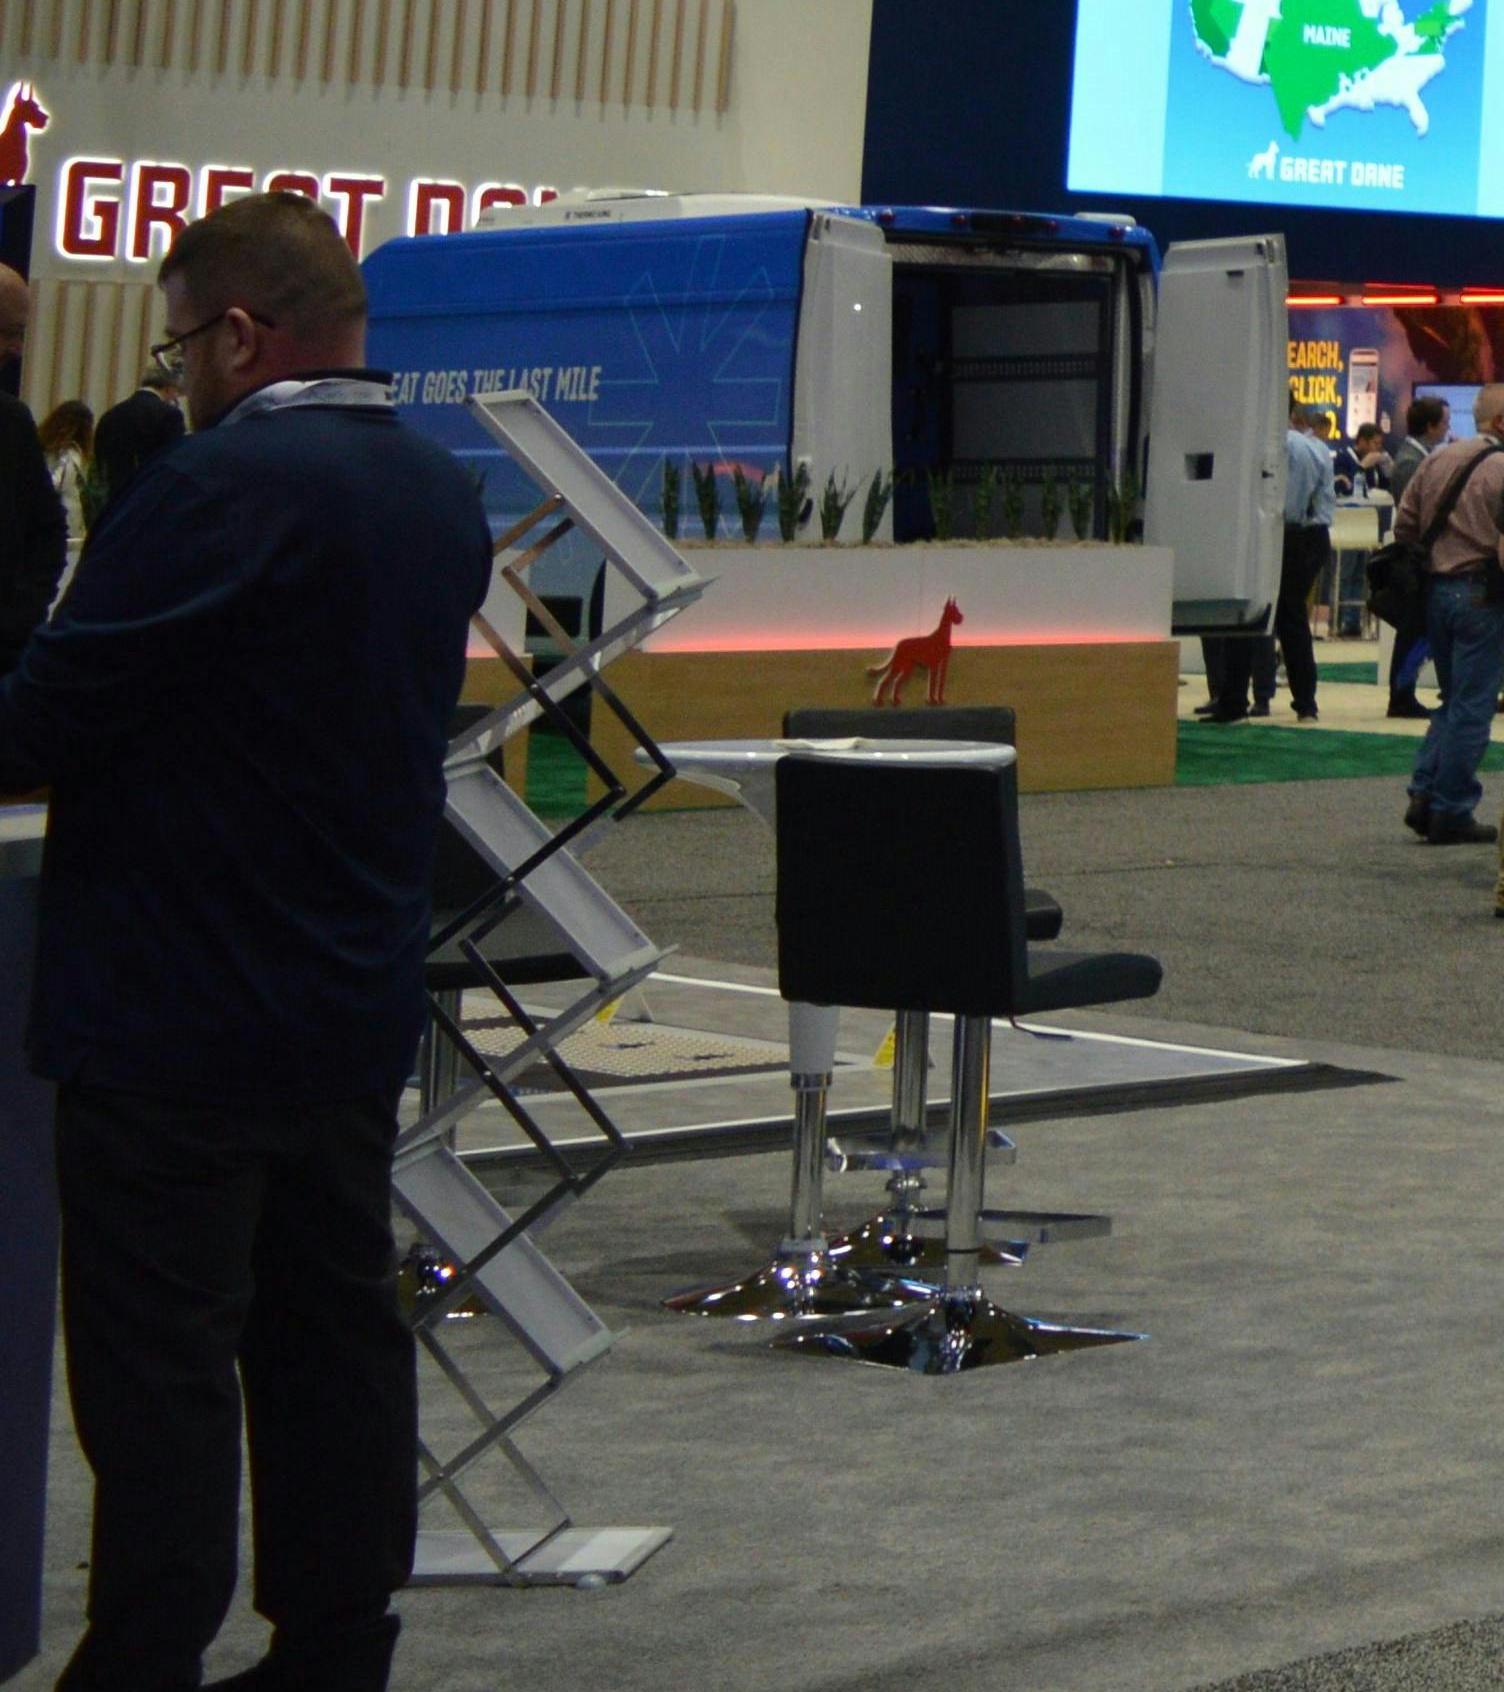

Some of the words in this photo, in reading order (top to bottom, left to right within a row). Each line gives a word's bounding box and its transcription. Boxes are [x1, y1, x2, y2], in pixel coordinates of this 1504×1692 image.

[1302, 23, 1351, 48] MAINE
[1280, 156, 1347, 185] GREAT
[1350, 162, 1404, 189] DANE
[422, 369, 469, 405] GOES
[473, 368, 505, 395] THE
[508, 367, 553, 402] LAST
[555, 365, 602, 402] MILE
